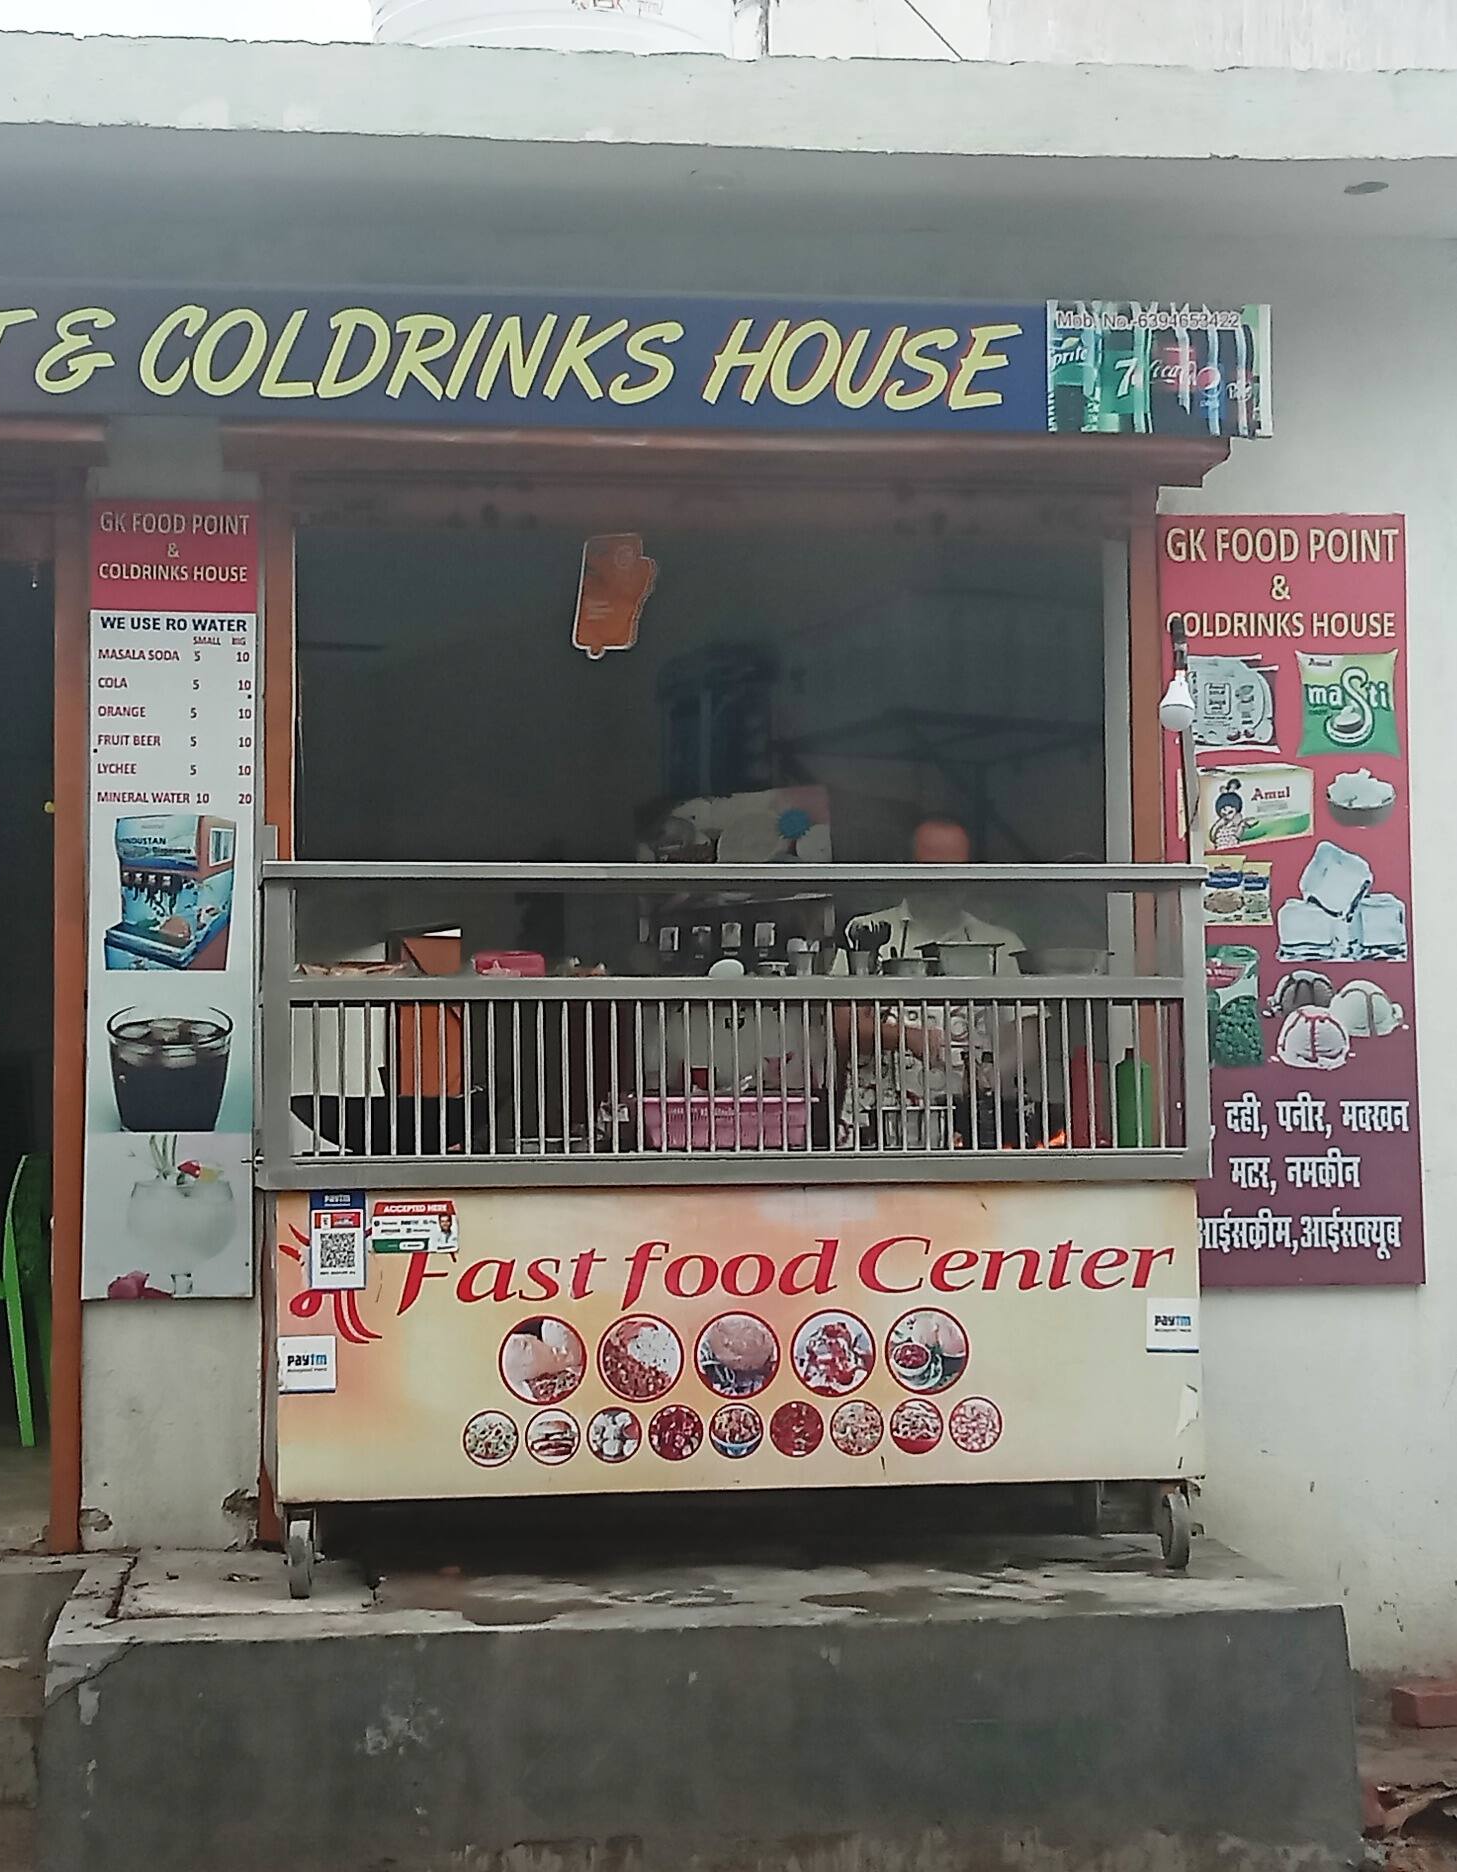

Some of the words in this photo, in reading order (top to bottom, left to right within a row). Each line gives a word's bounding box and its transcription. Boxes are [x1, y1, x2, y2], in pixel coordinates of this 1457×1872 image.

[33, 306, 117, 394] &
[138, 304, 685, 405] COLDRINKS
[702, 317, 1023, 411] HOUSE
[100, 512, 126, 533] GK
[132, 513, 186, 534] FOOD
[192, 514, 250, 536] POINT
[167, 542, 180, 558] &
[1166, 528, 1208, 563] GK
[1215, 528, 1300, 563] FOOD
[1309, 529, 1399, 563] POINT
[99, 563, 189, 581] COLDRINKS
[194, 566, 248, 582] HOUSE
[1271, 574, 1291, 601] &
[101, 616, 125, 630] WE
[130, 617, 160, 630] USE
[166, 618, 187, 631] RO
[192, 618, 247, 632] WATER
[1312, 612, 1396, 638] HOUSE
[193, 636, 221, 645] SMALL
[98, 649, 145, 661] MASALA
[148, 650, 180, 661] SODA
[194, 651, 201, 662] 5
[236, 651, 250, 662] 10
[98, 677, 128, 688] COLA
[193, 679, 200, 690] 5
[238, 680, 252, 691] 10
[98, 706, 146, 718] ORANGE
[190, 707, 197, 719] 5
[238, 708, 252, 719] 10
[98, 735, 130, 746] FRUIT
[133, 735, 161, 747] BEER
[190, 736, 197, 747] 5
[239, 737, 252, 748] 10
[97, 763, 137, 775] LYCHEE
[190, 765, 197, 776] 5
[238, 765, 252, 776] 10
[97, 792, 149, 803] MINERAL
[151, 793, 190, 804] WATER
[196, 793, 210, 804] 10
[238, 794, 252, 805] 20
[1251, 786, 1291, 801] Amul
[1224, 1091, 1268, 1139] दही,
[1275, 1091, 1332, 1139] पनीर,
[1229, 1157, 1277, 1195] मटर,
[1285, 1147, 1361, 1188] नमकीन
[397, 1251, 607, 1316] Fast
[621, 1239, 839, 1312] food
[858, 1235, 1175, 1294] Center
